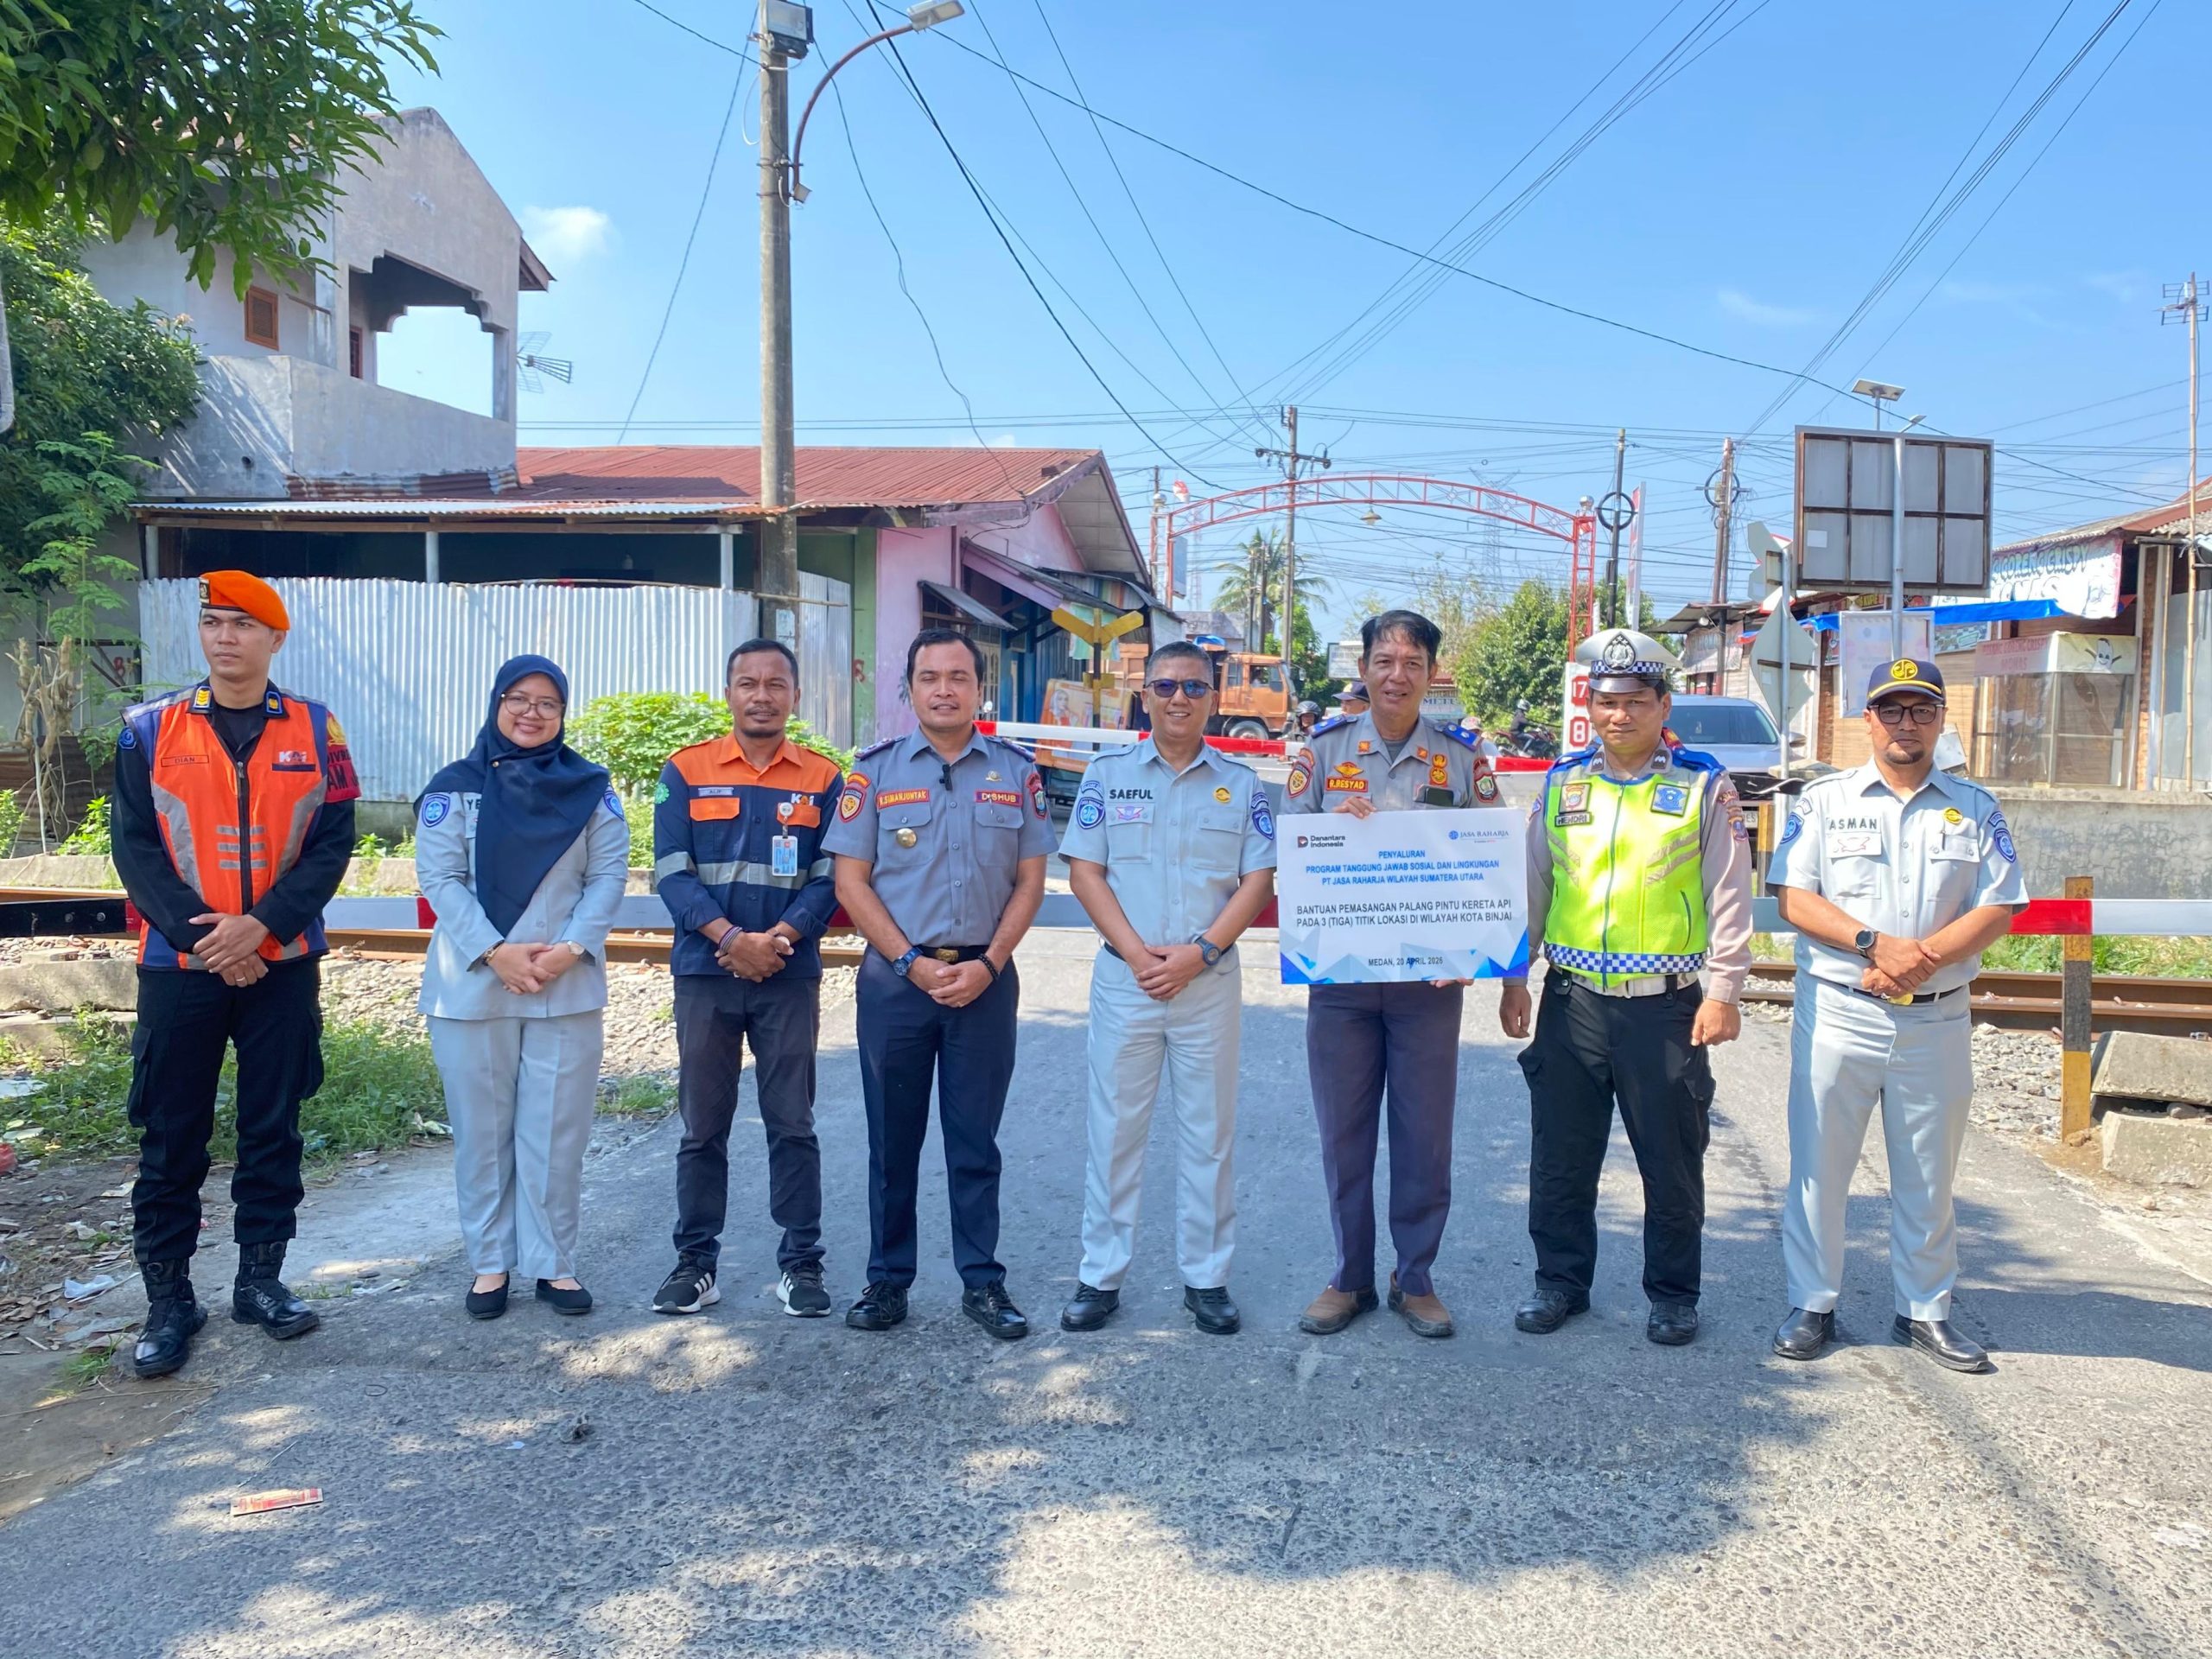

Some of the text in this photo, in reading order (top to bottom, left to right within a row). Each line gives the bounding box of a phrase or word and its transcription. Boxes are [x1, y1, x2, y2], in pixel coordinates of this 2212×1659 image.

[1572, 680, 1588, 699] 17
[1573, 721, 1586, 743] 8
[1329, 779, 1364, 790] R.RESYAD
[981, 792, 1017, 803] DSHUB
[1109, 788, 1154, 799] SAEFUL
[1829, 817, 1878, 830] ASMAN
[1378, 850, 1426, 859] PENYALURAN
[1306, 860, 1499, 874] PROGRAM TANGGUNG JAWAB SOSIAL DAN LINGKUNGAN
[1322, 877, 1331, 886] PT
[1387, 874, 1418, 883] WILAYAH
[1420, 874, 1459, 882] SUMATERA
[1460, 873, 1484, 881] UTARA
[1297, 899, 1511, 915] BANTUAN PEMASANGAN PALANG PINTU KERETA API
[1296, 912, 1512, 928] PADA 3 (TIGA) TITIK LOKASI DI WILAYAH KOTA BINJAI
[1368, 958, 1395, 967] MEDAN,
[1396, 957, 1405, 966] 20
[1406, 957, 1426, 965] APRIL
